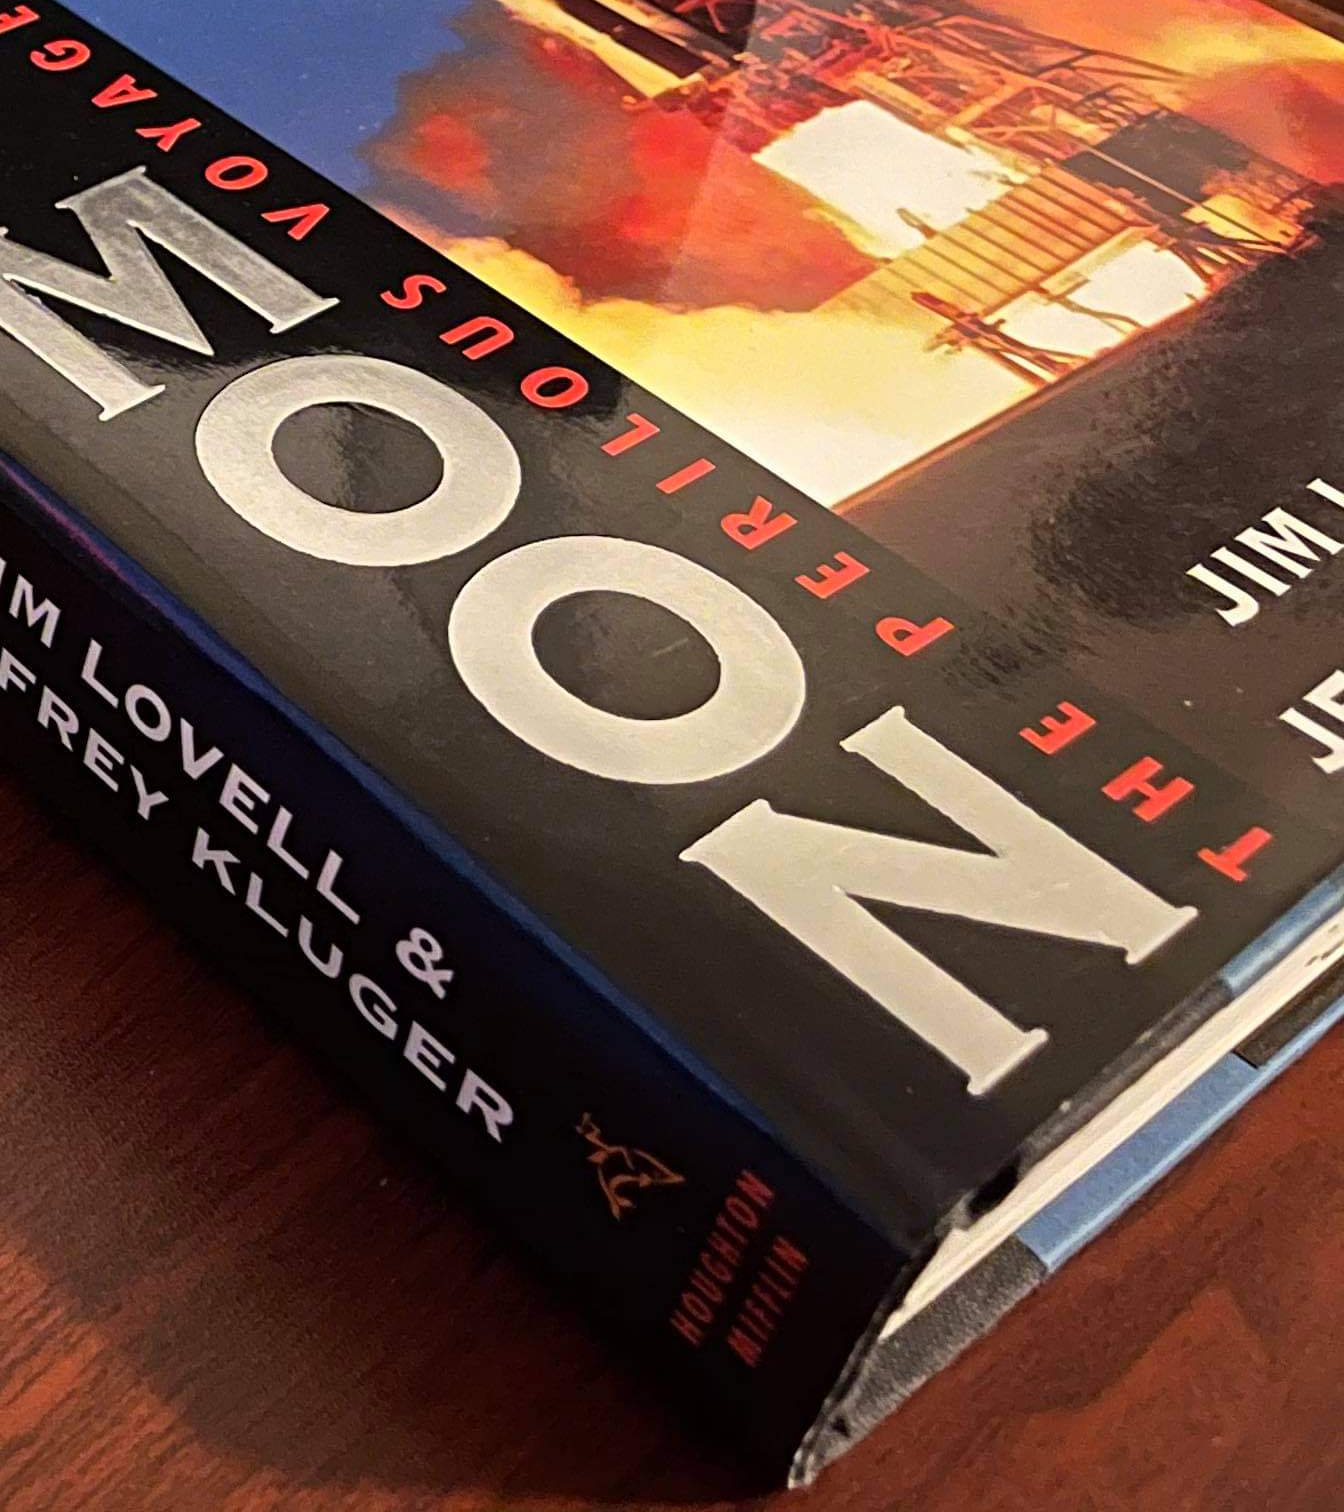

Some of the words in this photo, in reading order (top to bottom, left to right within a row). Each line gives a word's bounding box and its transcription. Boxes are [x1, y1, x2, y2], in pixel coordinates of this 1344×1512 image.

[379, 273, 956, 657] PERILOUS
[1185, 507, 1344, 627] JIM
[81, 638, 360, 925] LOVELL
[395, 927, 454, 999] &
[1019, 701, 1273, 882] THE
[191, 826, 513, 1143] KLUGER
[670, 1169, 776, 1346] HOUGHTON
[727, 1236, 809, 1368] MIFFLIN
